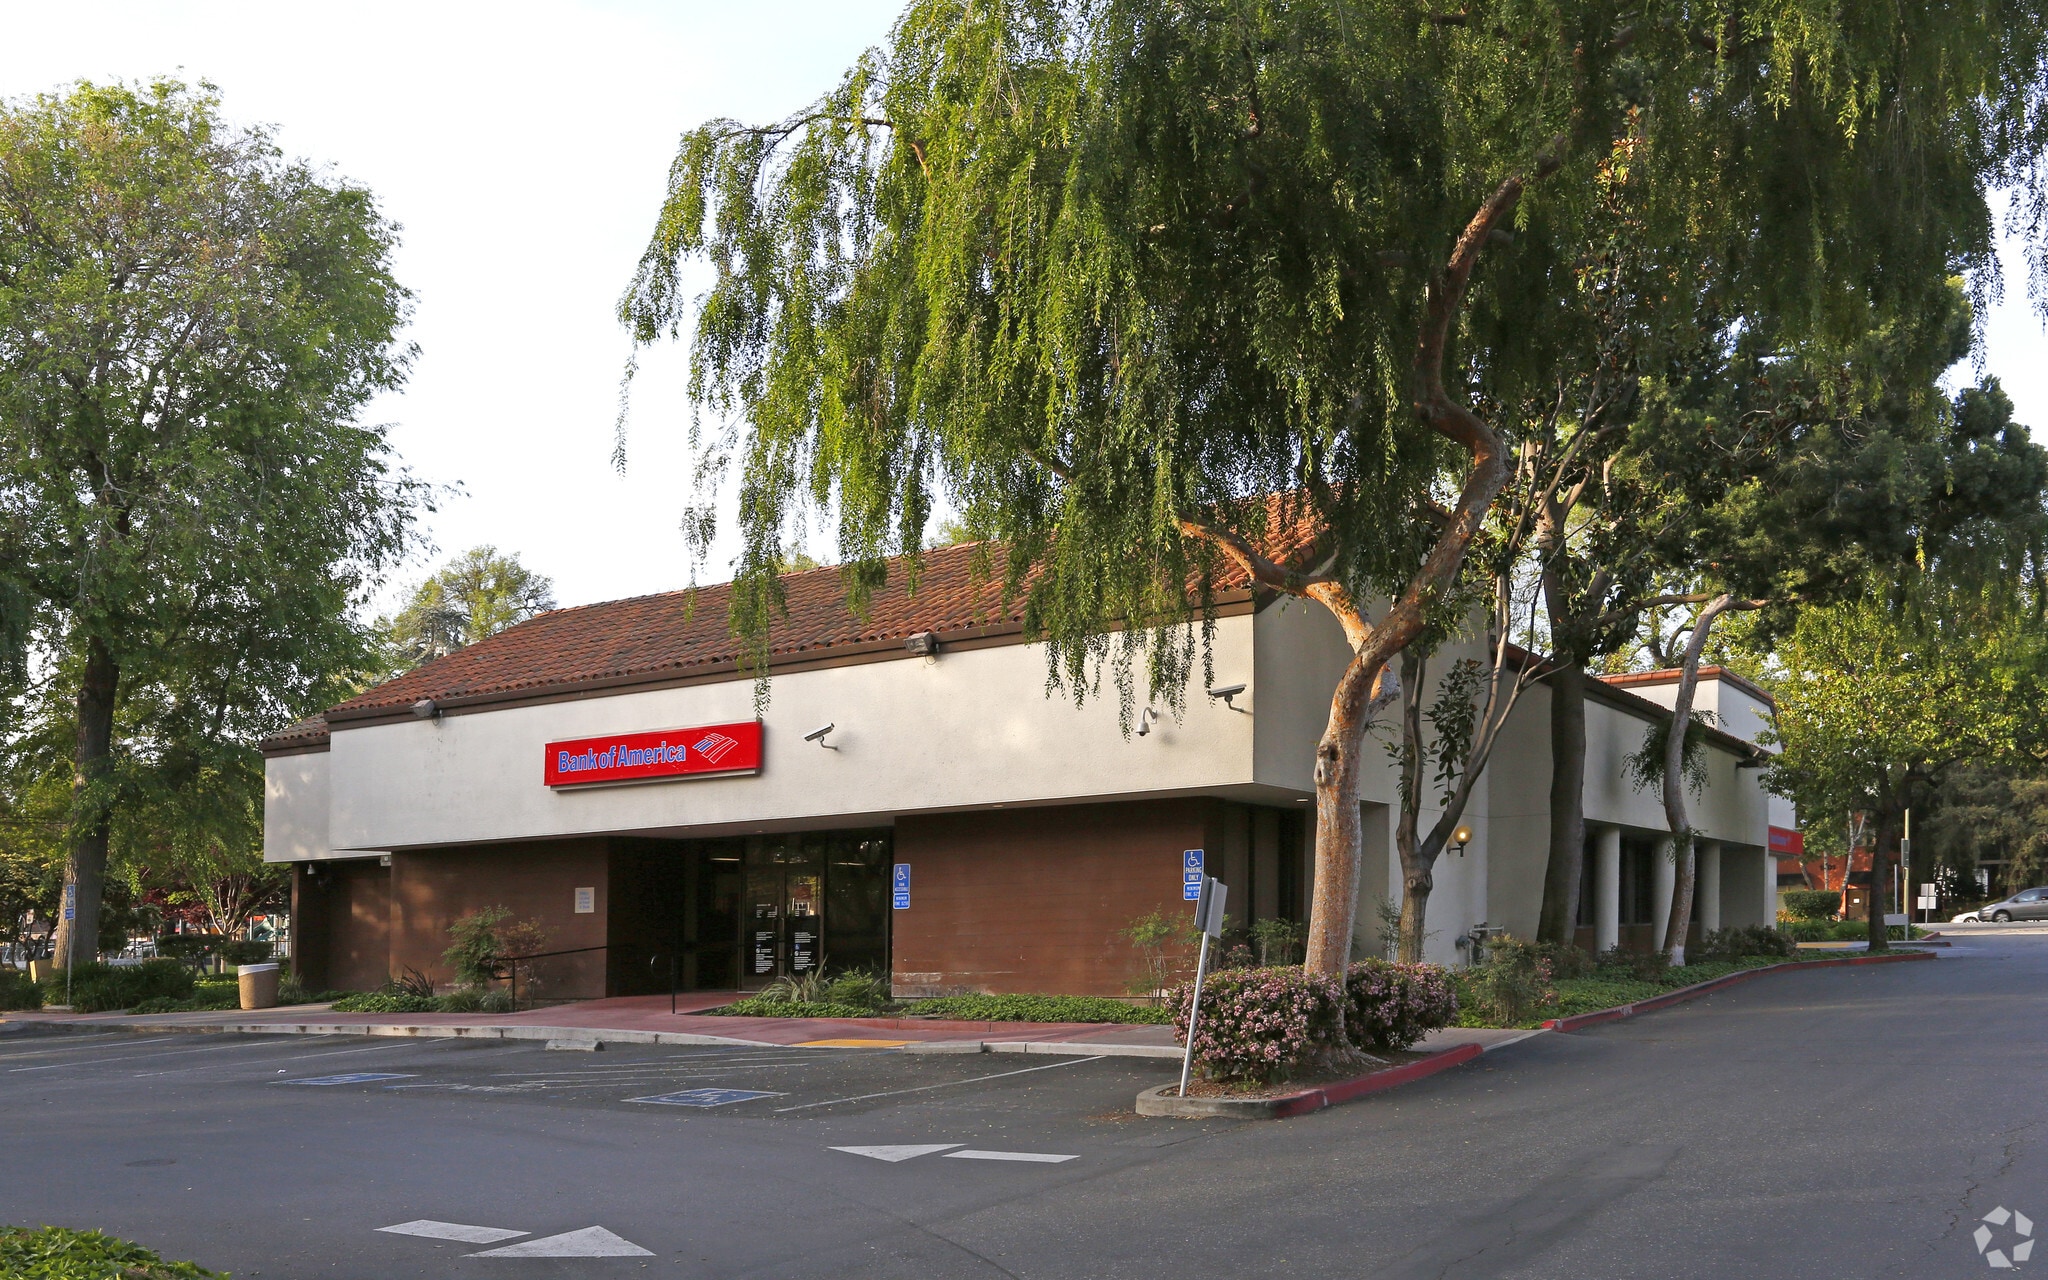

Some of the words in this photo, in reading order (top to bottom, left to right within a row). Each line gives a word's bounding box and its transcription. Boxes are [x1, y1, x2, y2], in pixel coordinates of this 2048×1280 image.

[558, 749, 597, 773] Bank
[599, 746, 615, 768] of
[616, 741, 686, 767] America
